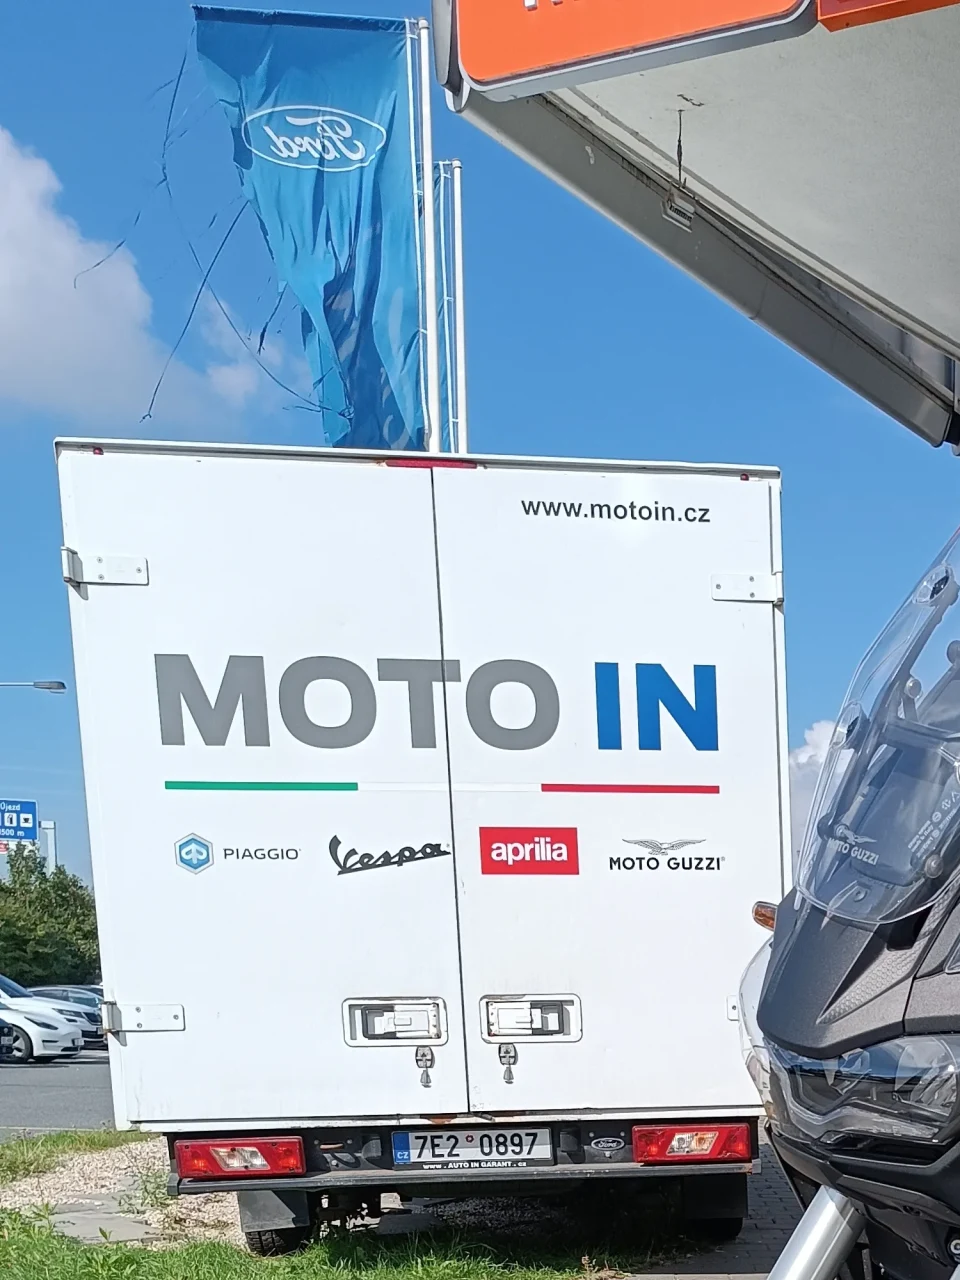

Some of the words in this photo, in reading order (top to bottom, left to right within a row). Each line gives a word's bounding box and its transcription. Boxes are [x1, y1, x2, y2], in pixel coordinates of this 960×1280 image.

[521, 500, 711, 523] www.motoin.cz
[153, 653, 561, 750] MOTO
[594, 661, 719, 751] IN
[222, 847, 299, 861] PIAGGIO
[328, 834, 452, 876] Vespa
[490, 836, 568, 866] aprilia
[609, 856, 660, 871] MOTO
[667, 856, 721, 871] GUZZI
[826, 837, 849, 854] MOTO
[851, 846, 879, 866] GUZZI
[397, 1151, 409, 1159] CZ
[414, 1134, 460, 1159] 7E2
[479, 1132, 538, 1157] 0897
